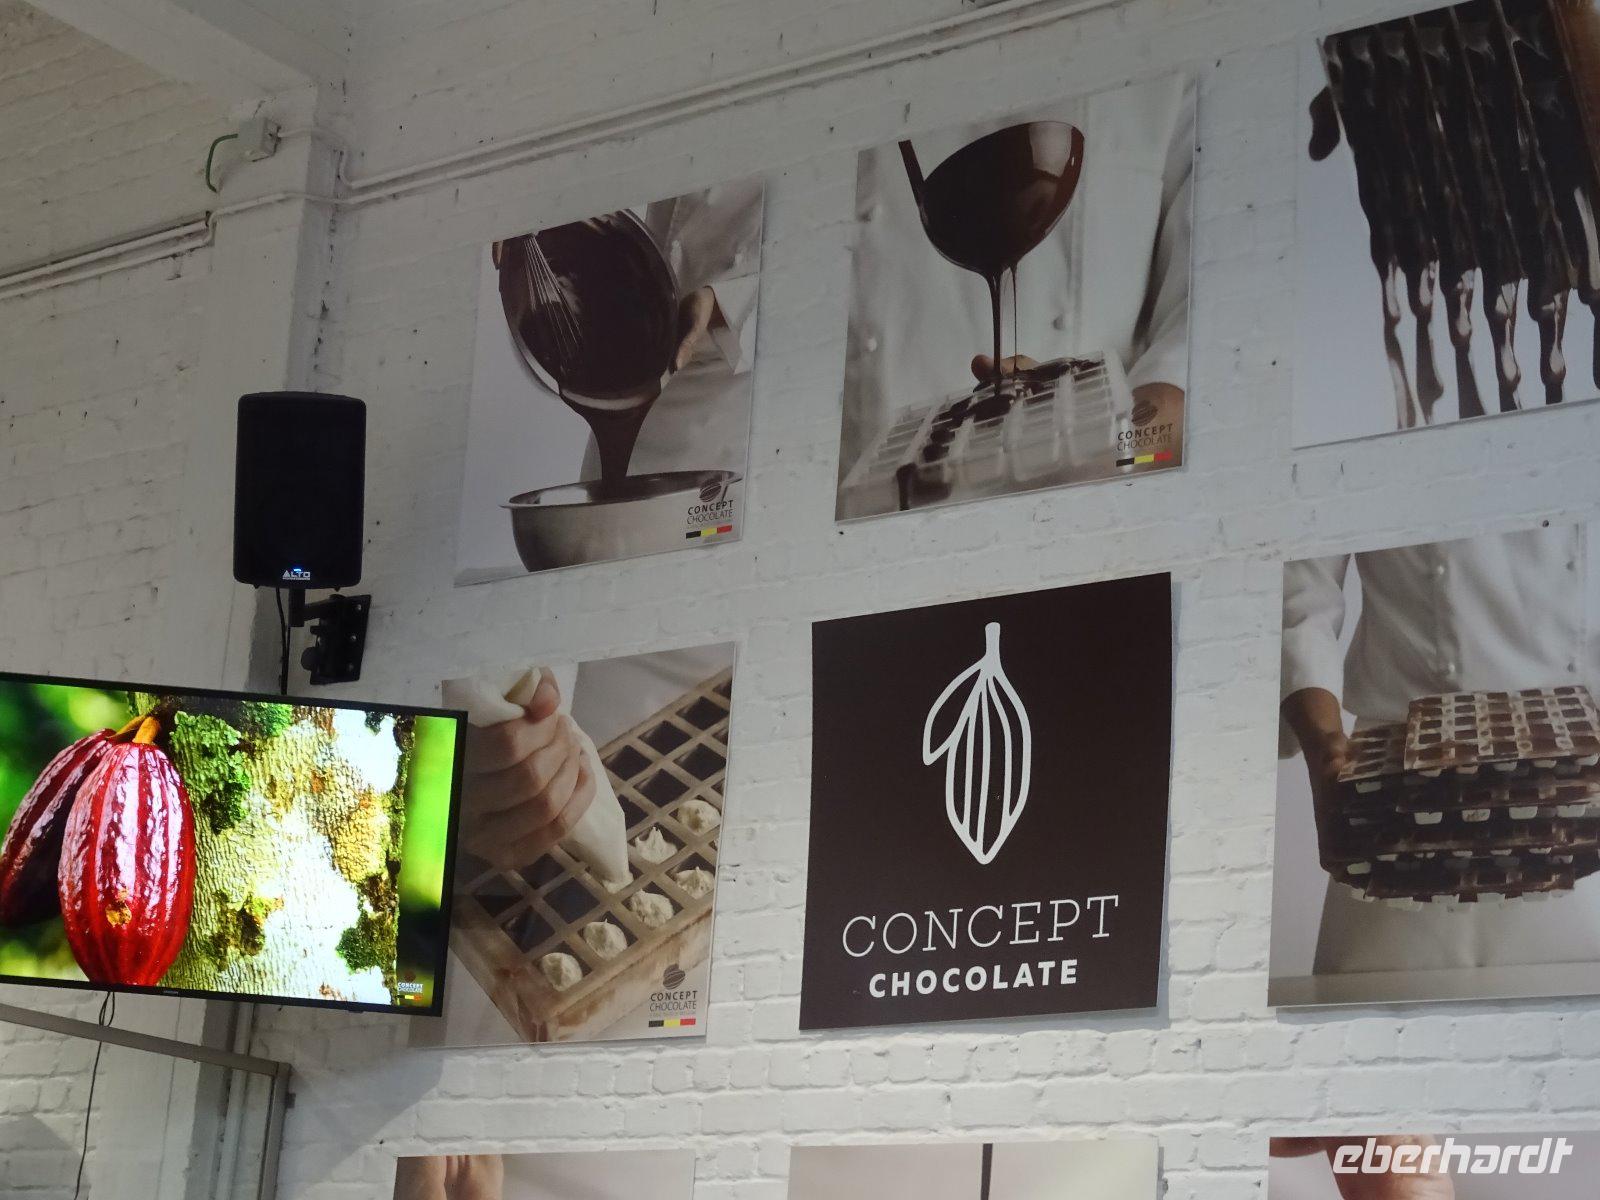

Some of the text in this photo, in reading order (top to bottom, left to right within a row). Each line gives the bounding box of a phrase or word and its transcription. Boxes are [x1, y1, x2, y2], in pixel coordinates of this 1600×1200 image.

[1117, 423, 1173, 441] CONCEPT
[1117, 434, 1172, 451] CHOCOLATE
[687, 500, 734, 516] CONCEPT
[686, 509, 733, 525] CHOCOLATE
[282, 569, 311, 578] ALTO
[842, 894, 1119, 958] CONCEPT
[869, 958, 1078, 998] CHOCOLATE
[650, 990, 698, 1002] CONCEPT
[649, 1000, 697, 1012] CHOCOLATE
